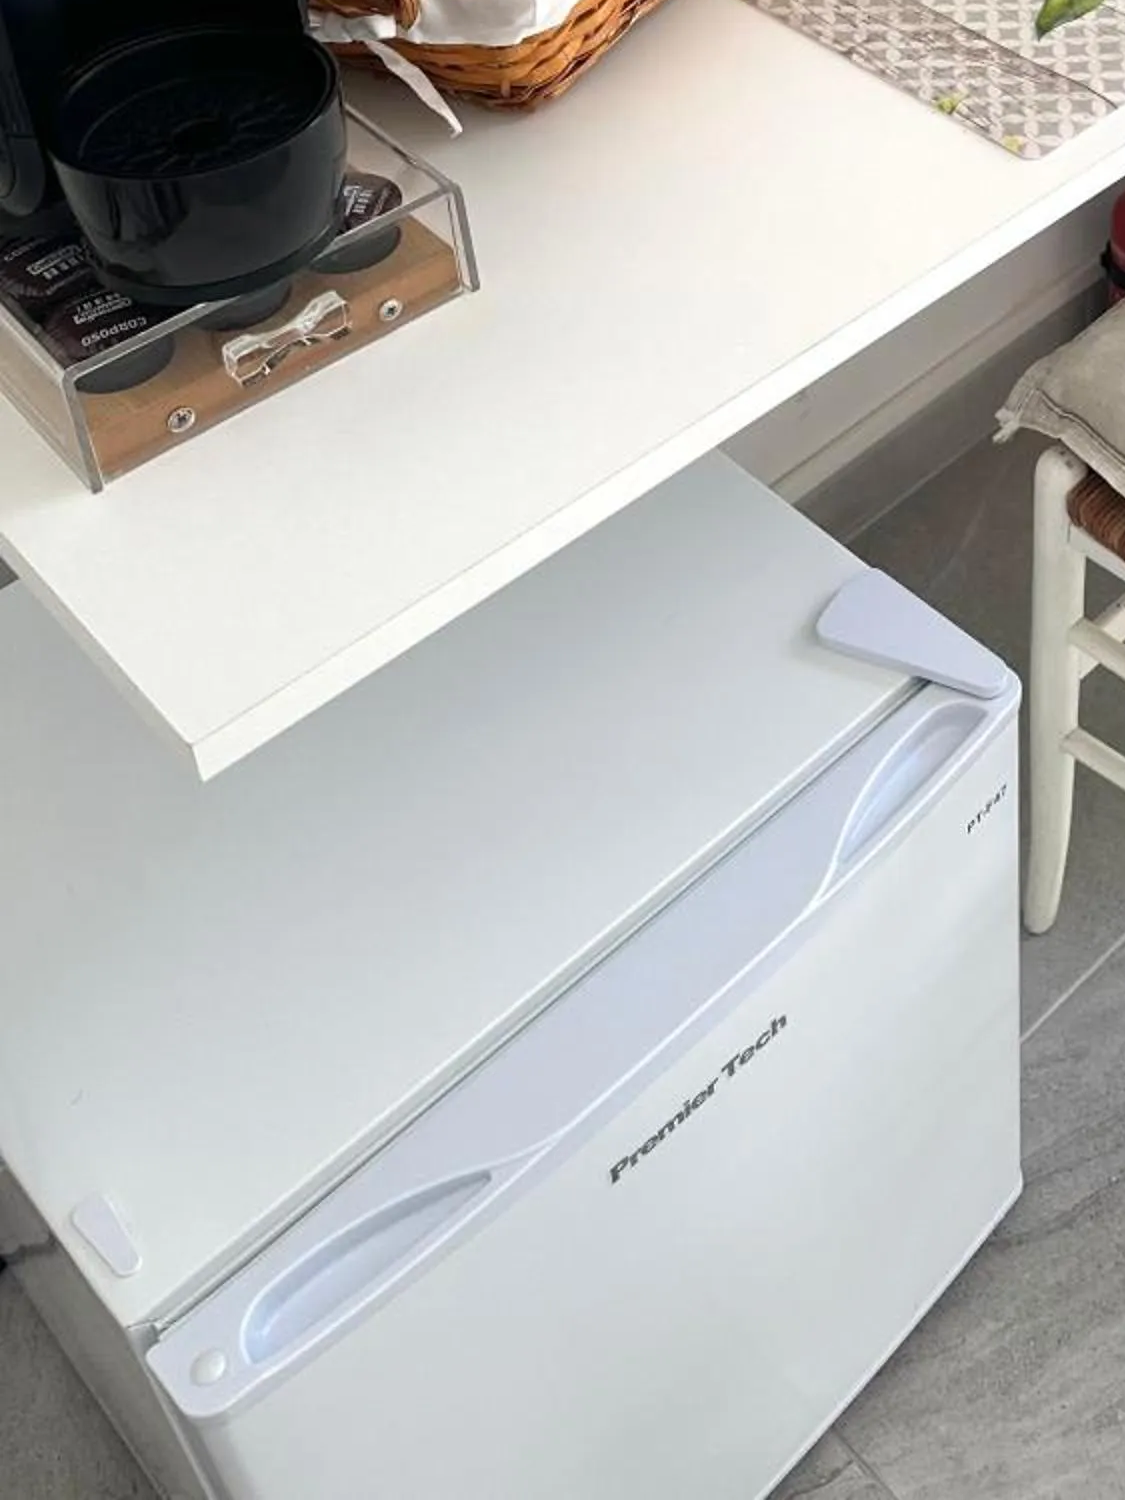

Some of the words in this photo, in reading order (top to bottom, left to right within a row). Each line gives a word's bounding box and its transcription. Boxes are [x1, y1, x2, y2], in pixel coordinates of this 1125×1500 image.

[81, 316, 147, 347] CORPOSO
[609, 1077, 718, 1185] Premier
[721, 1014, 787, 1078] Tech
